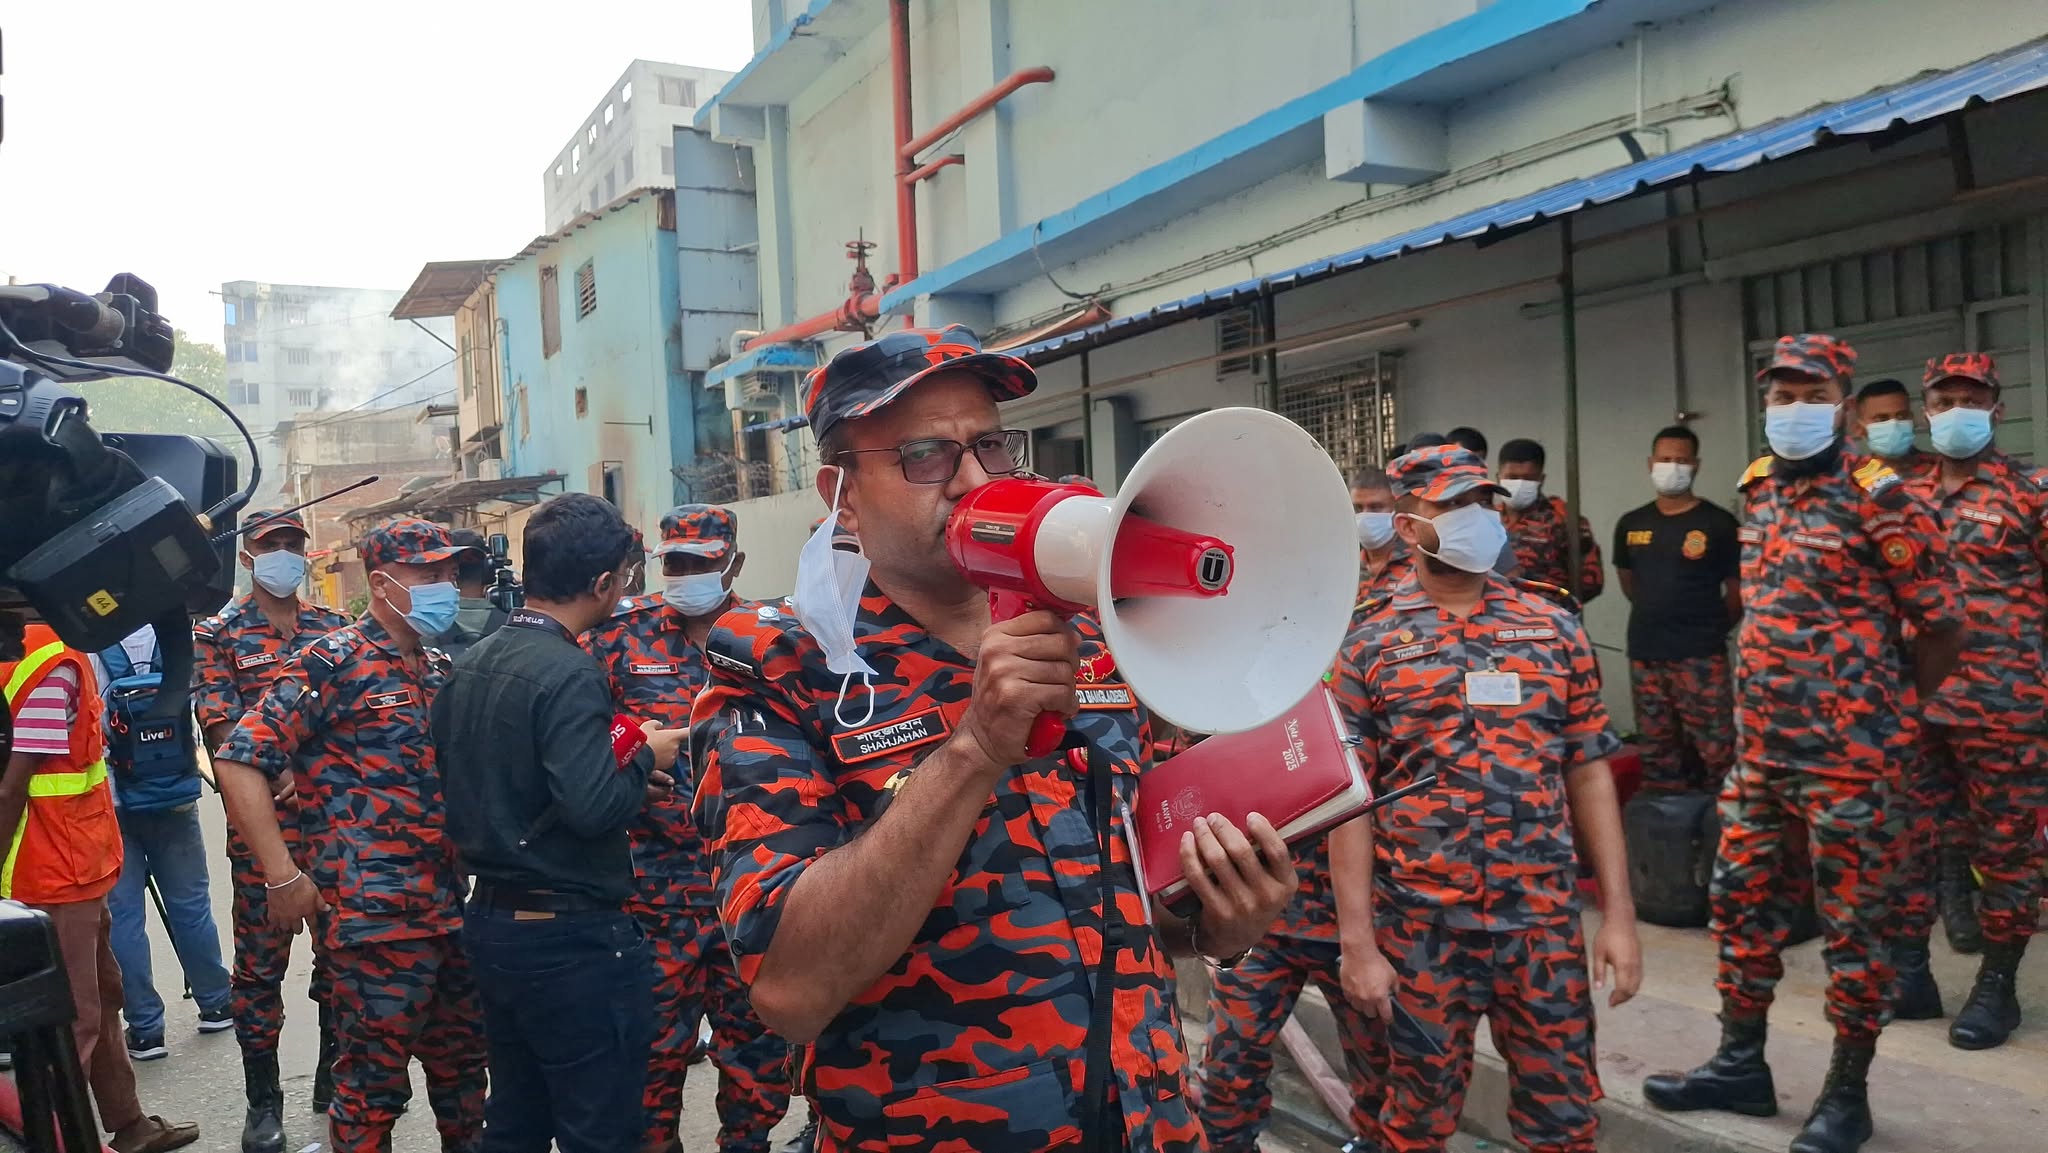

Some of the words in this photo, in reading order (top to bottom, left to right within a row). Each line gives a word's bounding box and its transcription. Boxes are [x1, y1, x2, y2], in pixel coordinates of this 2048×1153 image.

[1626, 530, 1654, 546] FIRE
[95, 597, 111, 610] 44
[1085, 689, 1131, 704] BANGLADESH
[140, 728, 173, 742] LiveU
[860, 727, 928, 754] SHAHJAHAN
[1287, 718, 1299, 738] Note
[1293, 738, 1309, 764] Book
[1282, 748, 1298, 771] 2025
